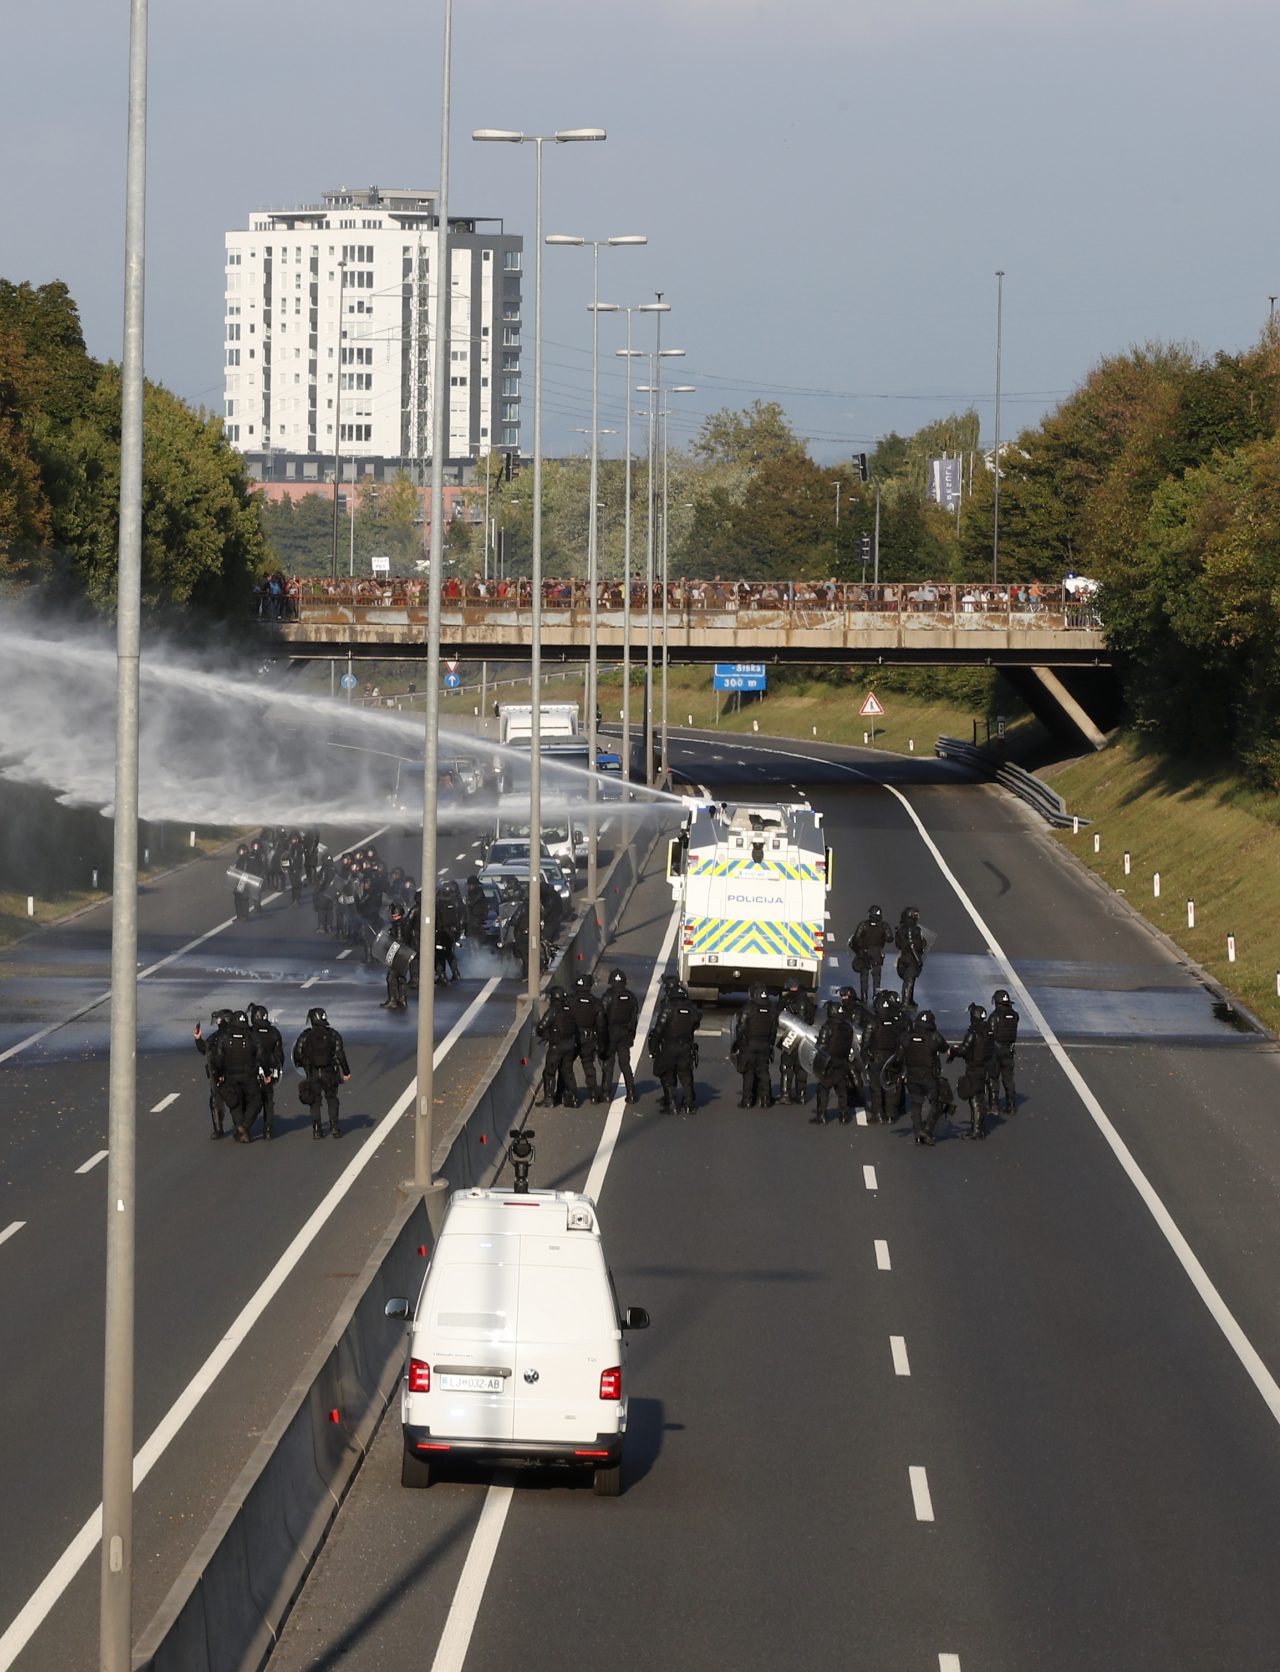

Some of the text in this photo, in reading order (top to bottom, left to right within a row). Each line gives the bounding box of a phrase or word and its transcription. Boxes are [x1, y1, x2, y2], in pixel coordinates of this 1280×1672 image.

[724, 678, 757, 688] 300 m
[727, 894, 784, 904] POLICIJA
[449, 1378, 501, 1390] LJ 032-AB
